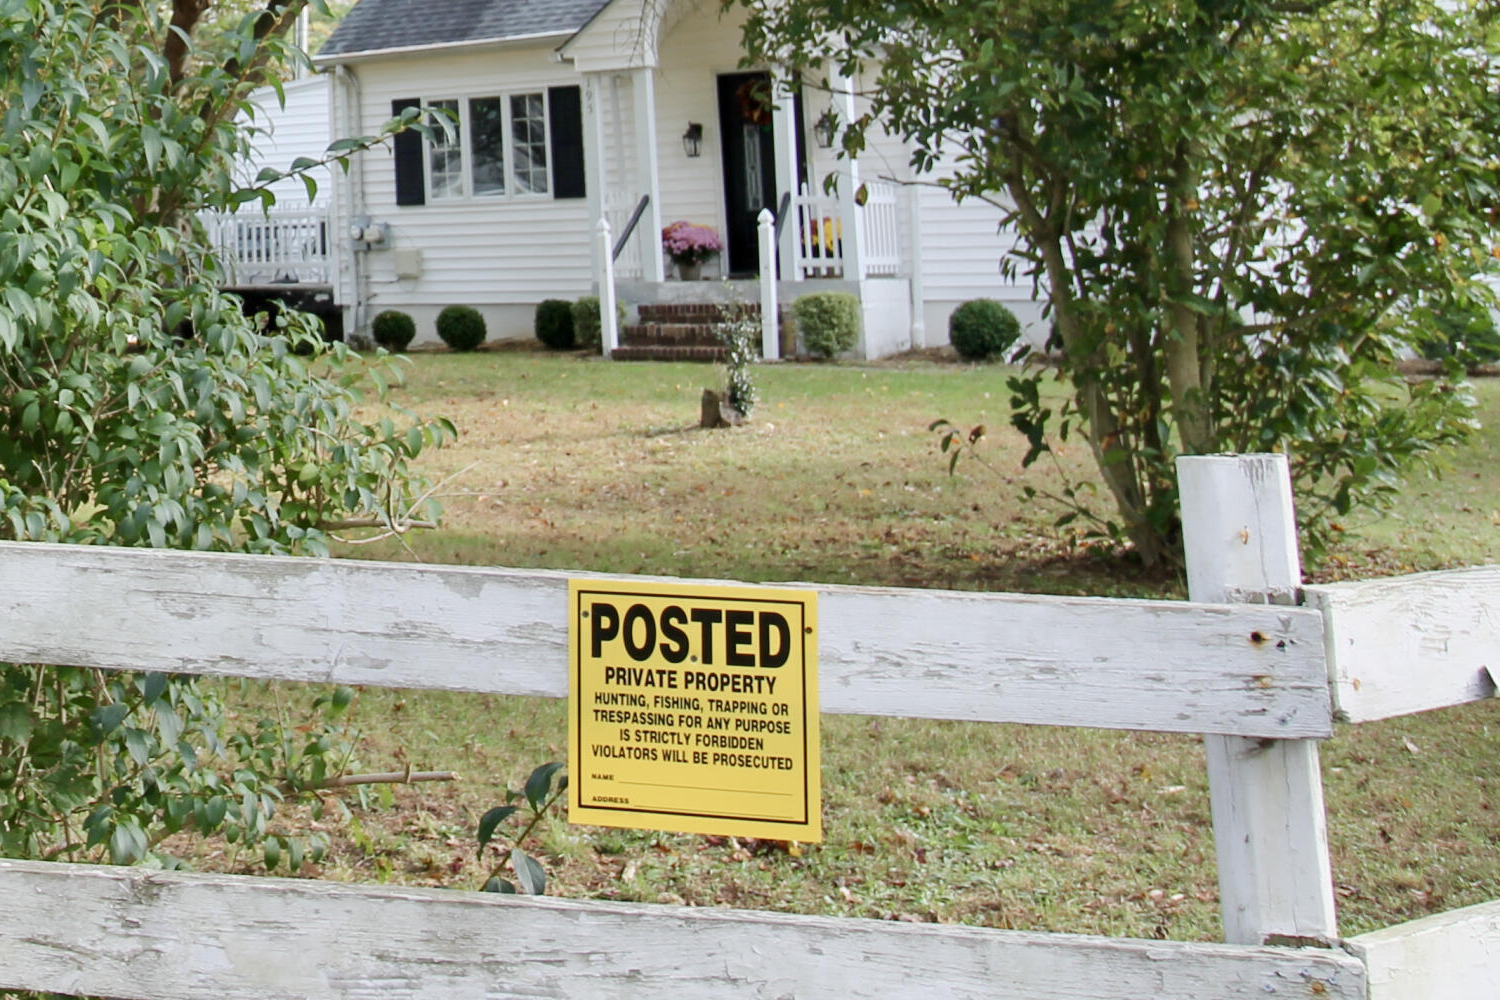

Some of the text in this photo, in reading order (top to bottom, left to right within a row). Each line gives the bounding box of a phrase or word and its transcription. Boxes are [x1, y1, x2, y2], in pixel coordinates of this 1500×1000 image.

[591, 602, 791, 669] POSTED
[604, 666, 777, 695] PRIVATE PROPERTY
[594, 691, 789, 716] HUNTING, FISHING, TRAPPING OR
[593, 709, 791, 734] TRESPASSING FOR ANY PURPOSE
[619, 728, 764, 751] IS STRICTLY FORBIDDEN
[591, 744, 793, 771] VIOLATORS WILL BE PROSECUTED
[591, 773, 615, 781] NAME
[592, 795, 629, 805] ADDRESS
